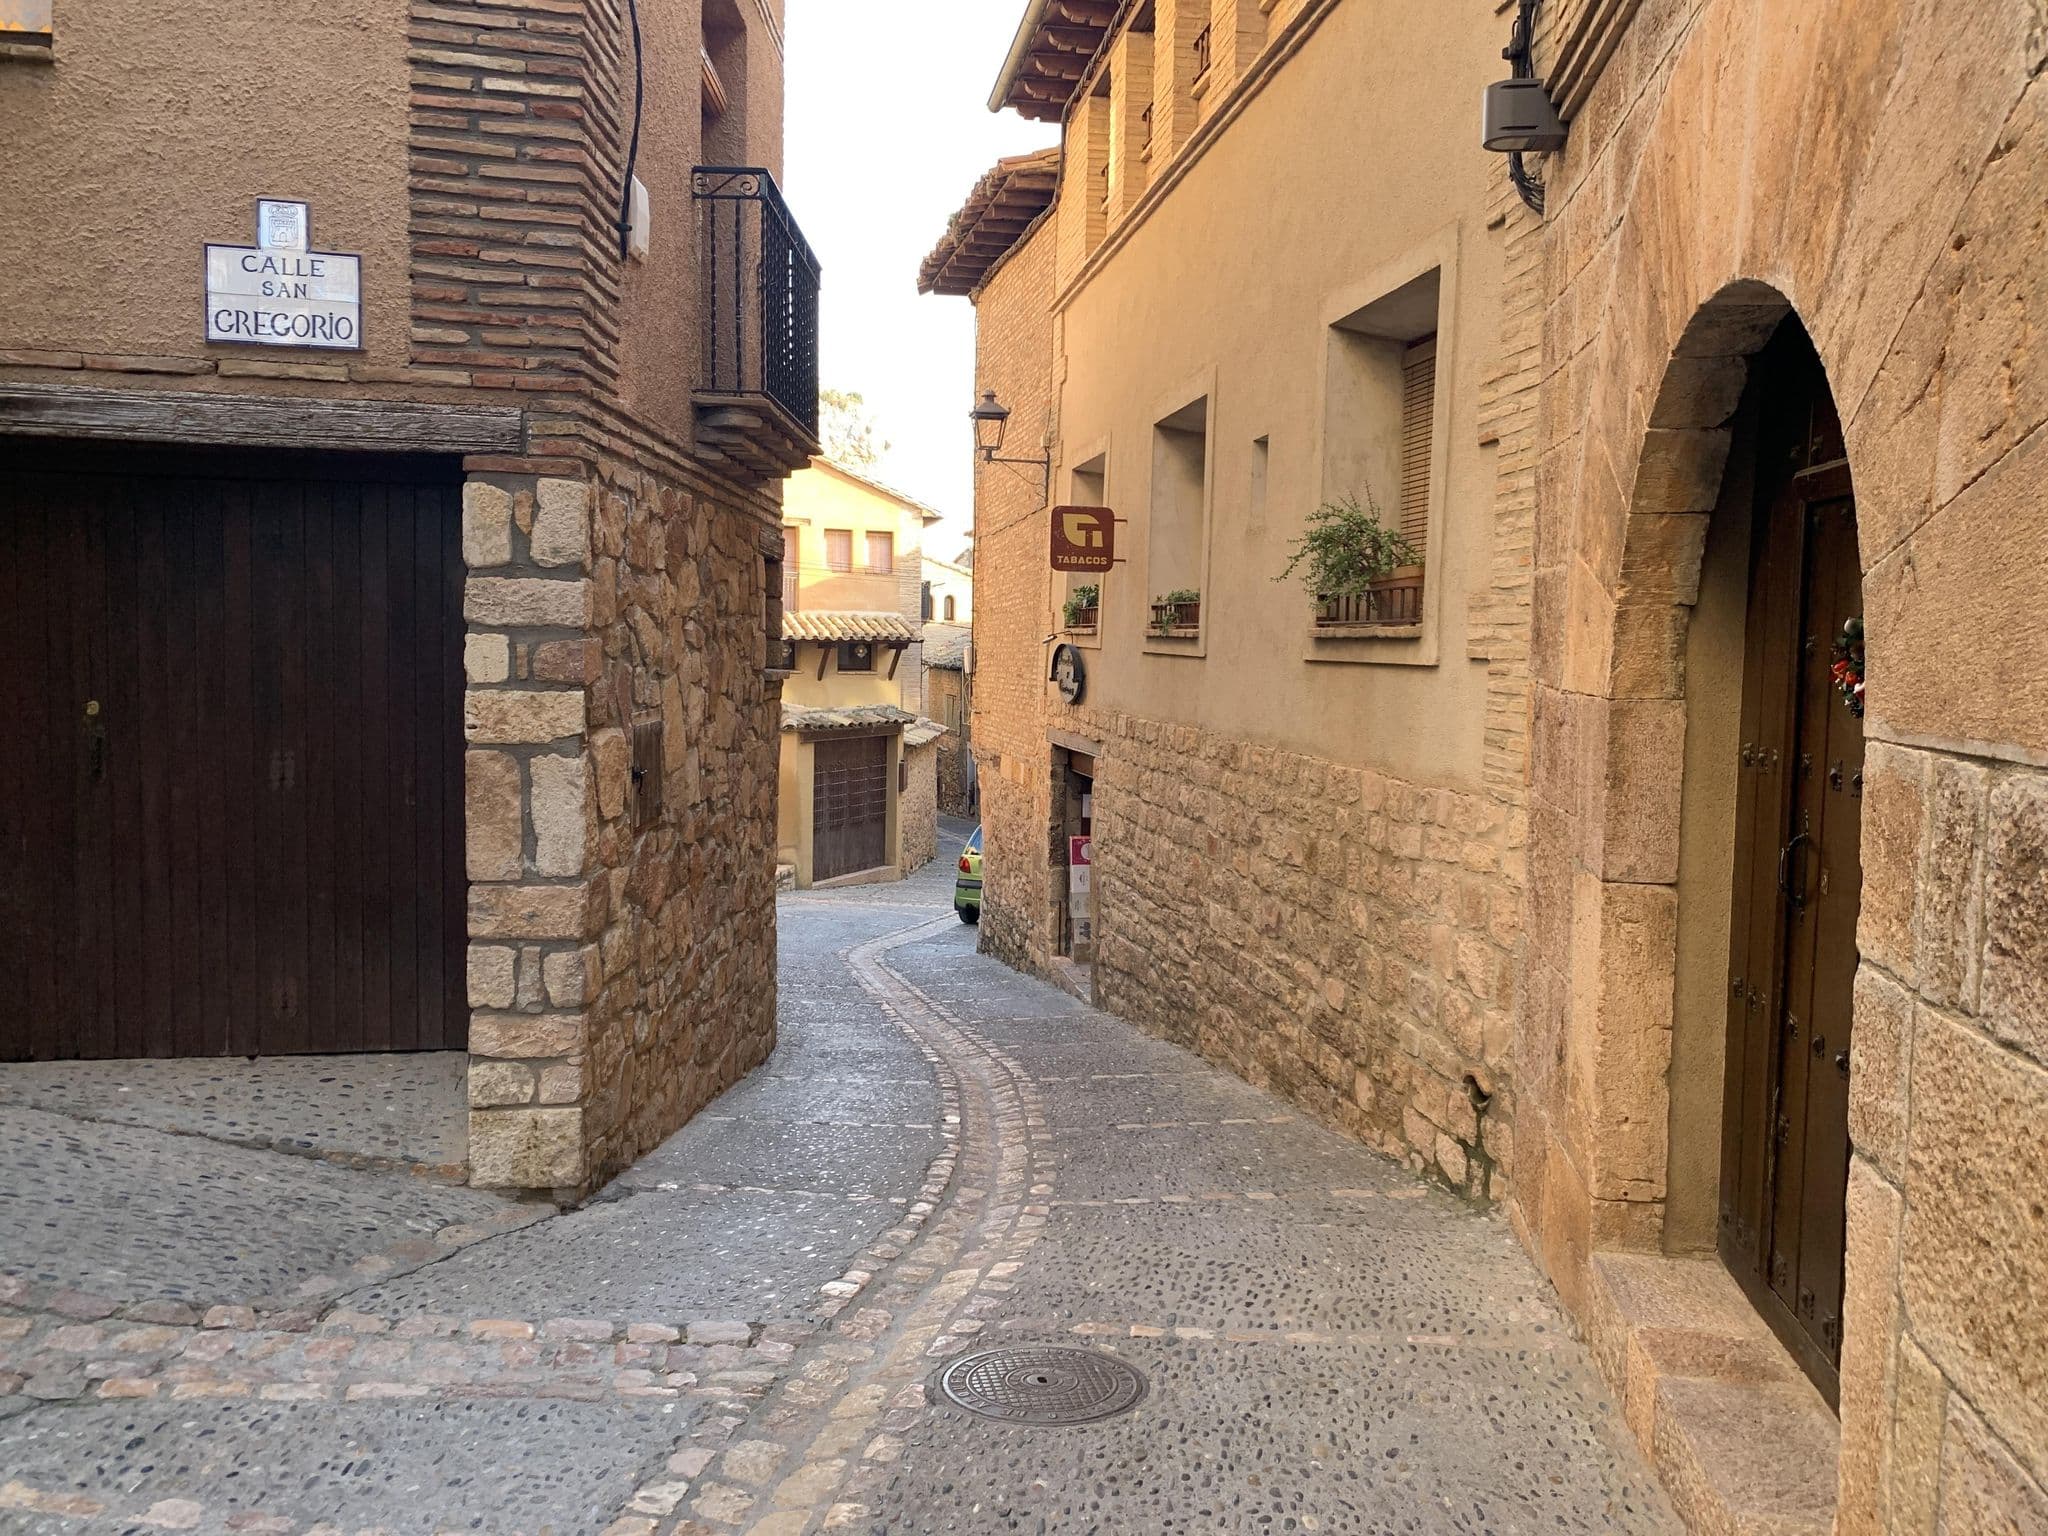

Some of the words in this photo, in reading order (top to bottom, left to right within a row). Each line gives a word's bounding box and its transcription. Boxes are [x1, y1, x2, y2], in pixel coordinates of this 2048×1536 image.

[241, 255, 325, 277] CALLE
[262, 280, 307, 298] SAN
[214, 309, 353, 341] GREGORIO
[1056, 555, 1108, 565] TABACOS
